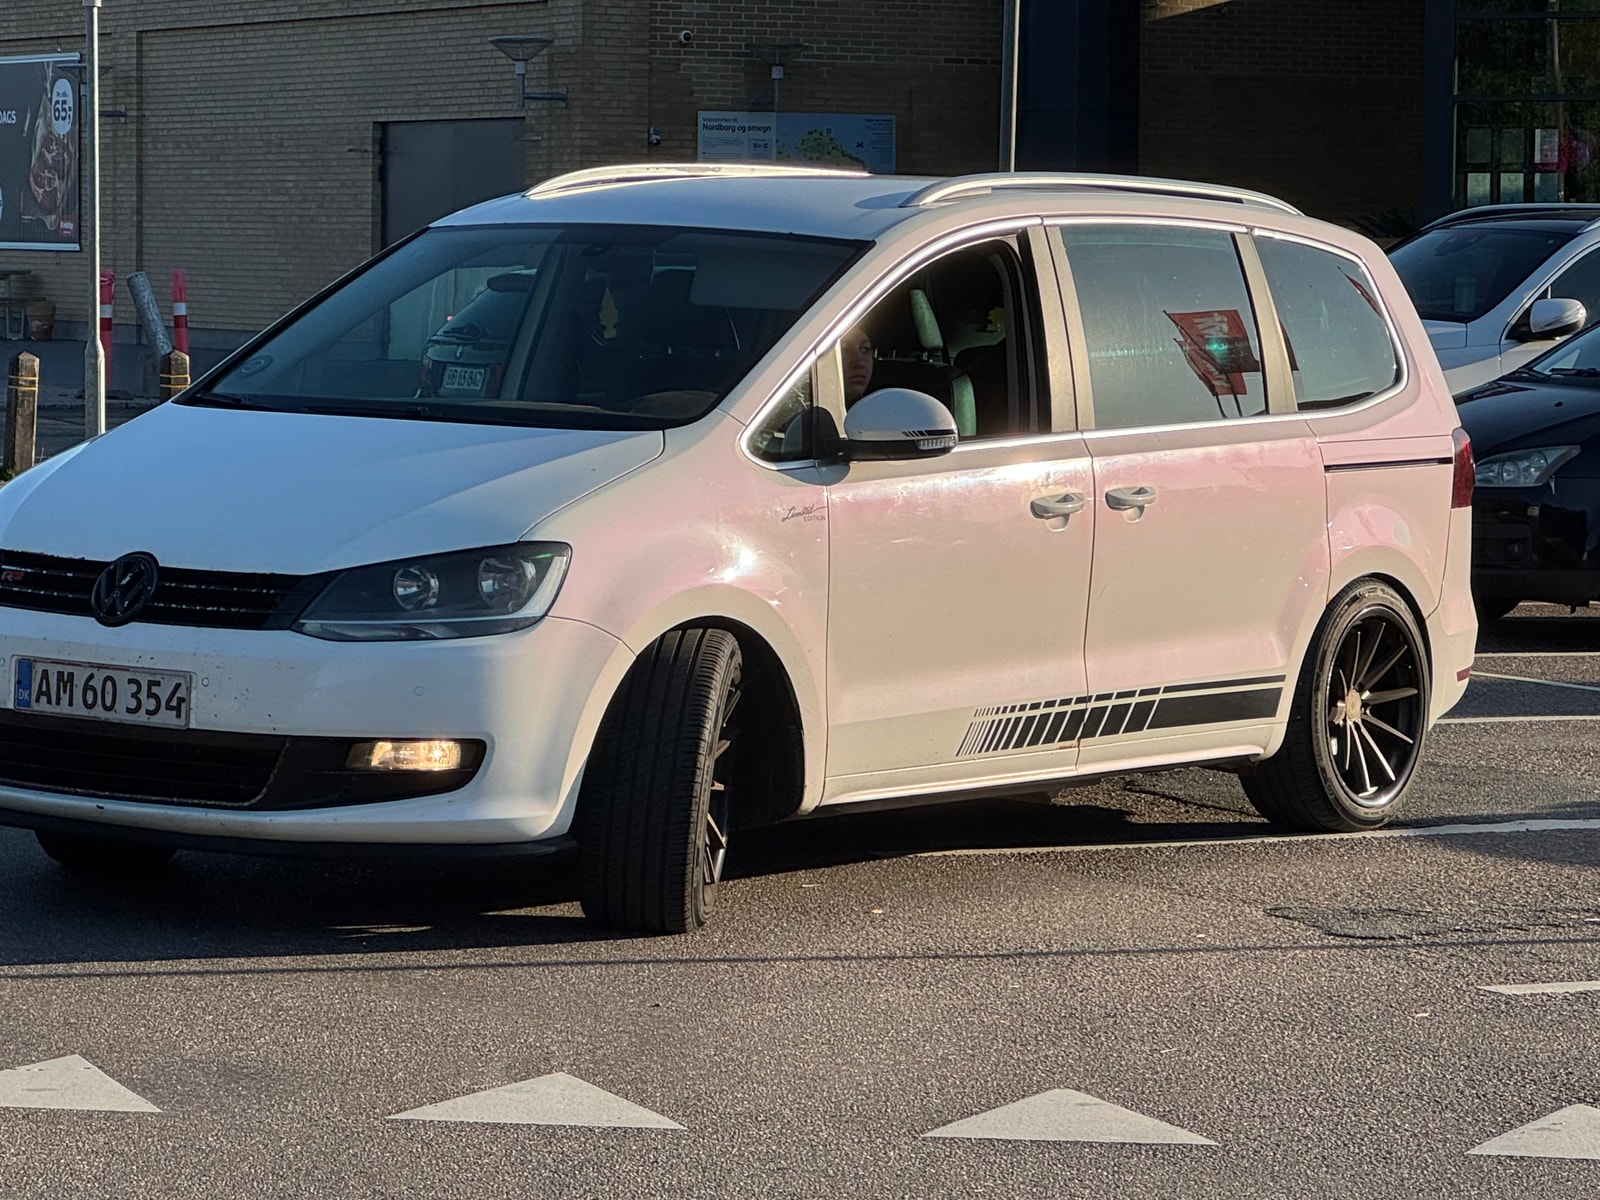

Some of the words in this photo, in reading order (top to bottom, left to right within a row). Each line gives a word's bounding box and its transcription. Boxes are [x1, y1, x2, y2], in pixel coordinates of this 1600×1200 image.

[702, 123, 736, 132] Nordborg
[747, 125, 772, 134] omegn
[18, 689, 30, 700] DK
[34, 669, 74, 707] AM
[82, 673, 118, 711] 60
[125, 679, 186, 718] 354
